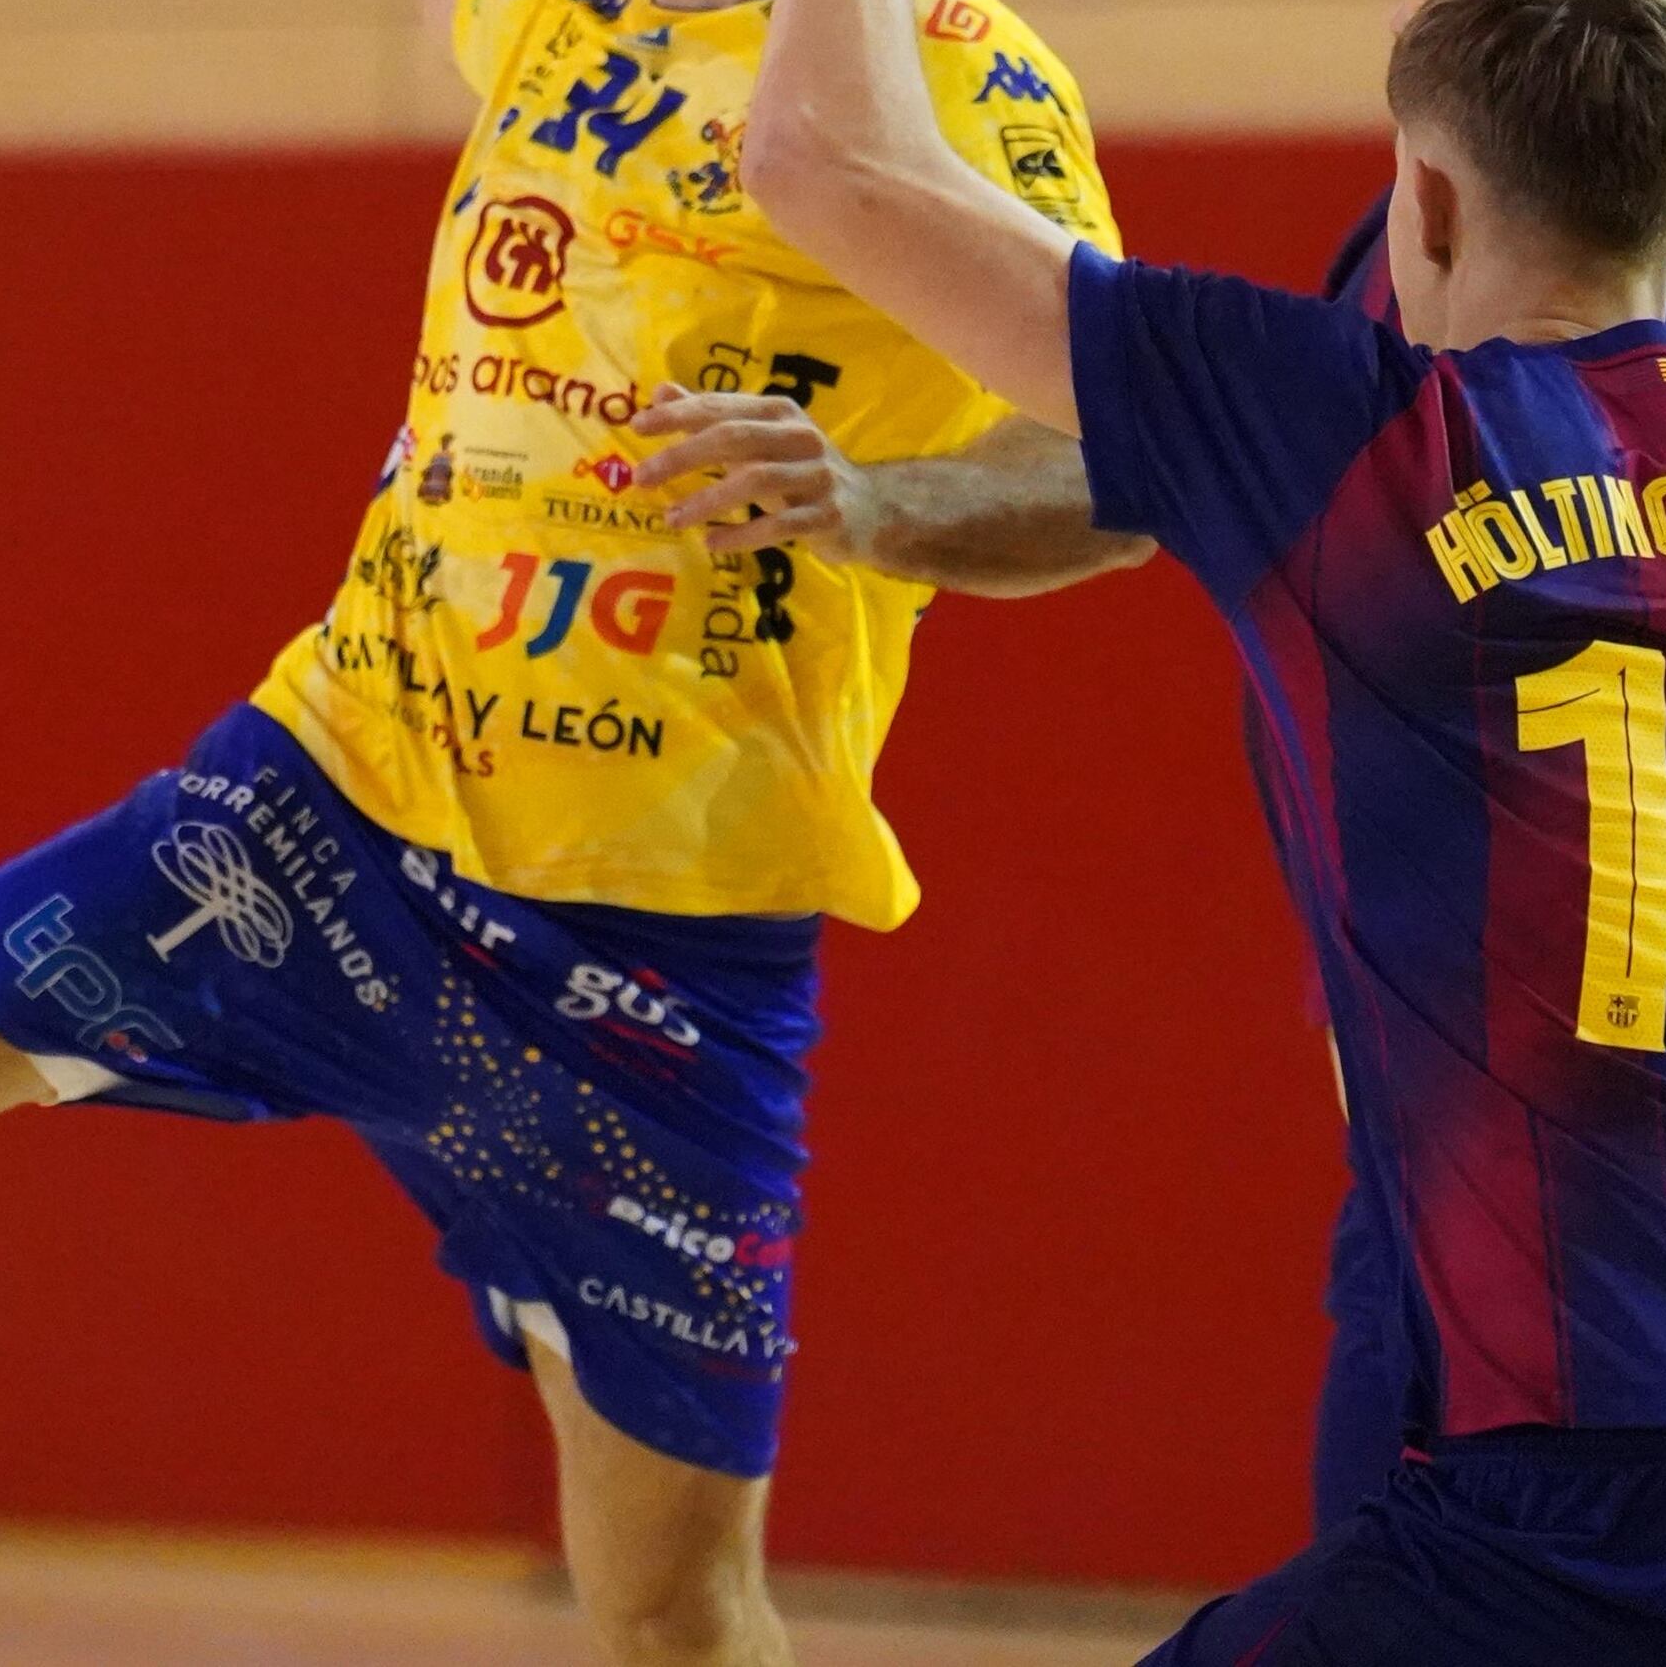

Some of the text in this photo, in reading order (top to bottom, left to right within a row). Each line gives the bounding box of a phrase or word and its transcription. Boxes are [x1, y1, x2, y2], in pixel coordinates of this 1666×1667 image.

[472, 354, 651, 425] arand
[475, 551, 676, 660] JJG
[465, 689, 499, 739] Y
[521, 699, 664, 757] LEÓN
[253, 765, 358, 895] FINCA
[161, 767, 388, 1008] ORREMILANOS
[579, 1278, 749, 1356] CASTILLA
